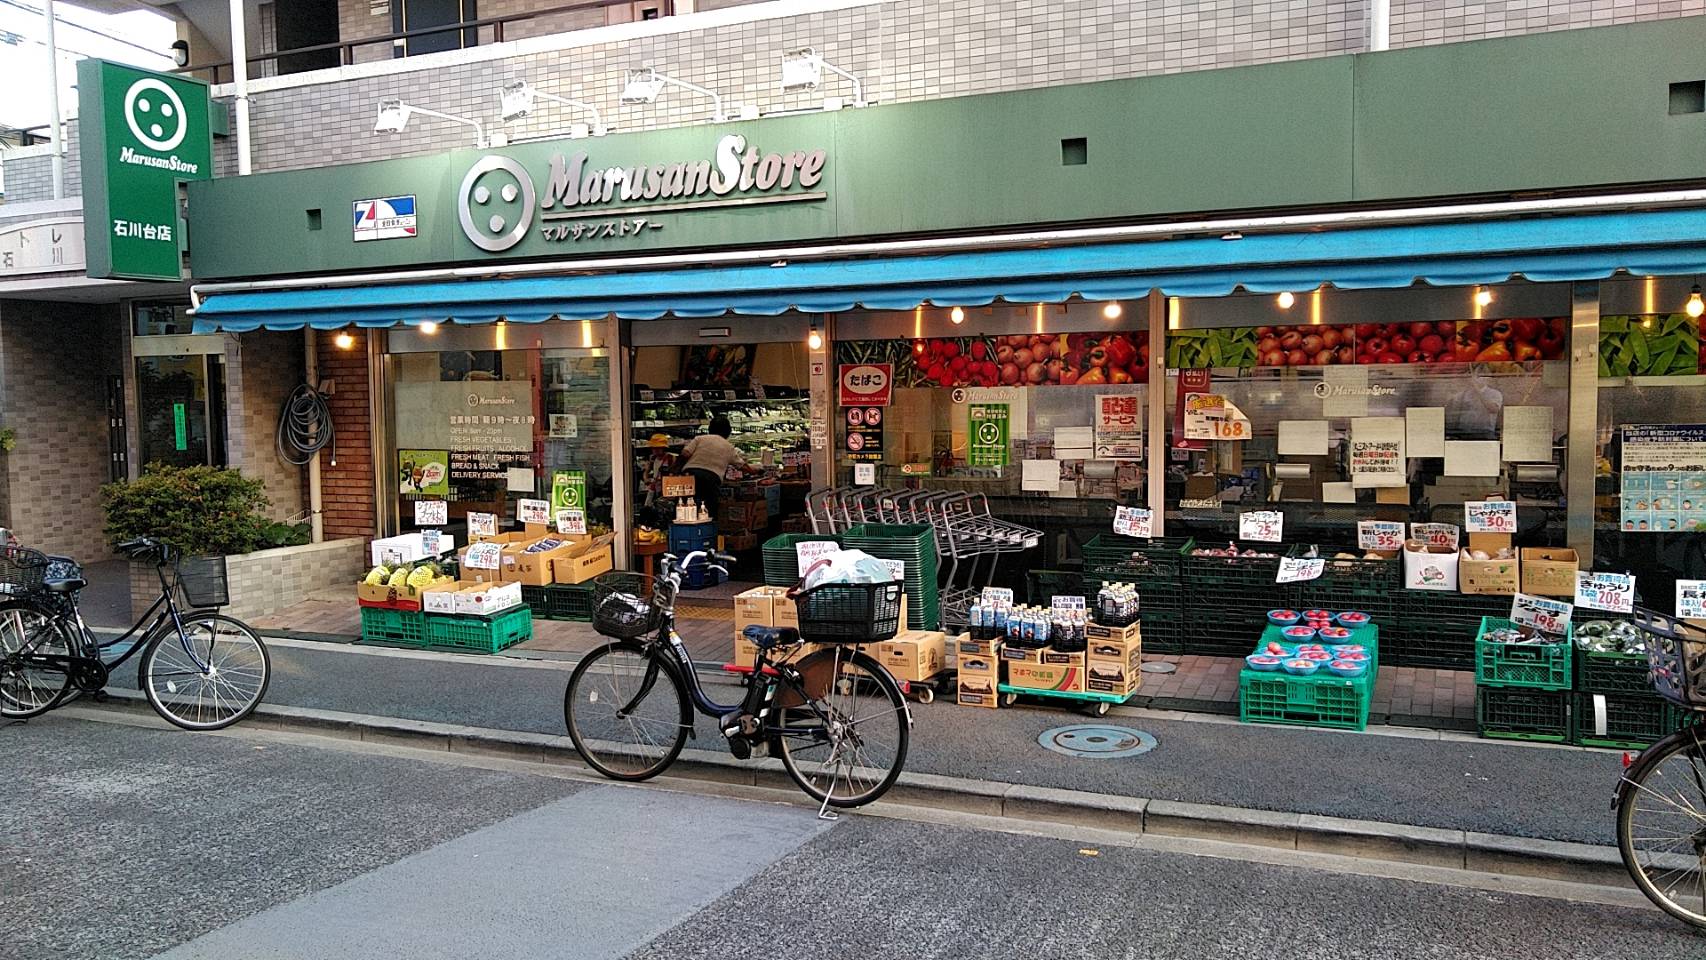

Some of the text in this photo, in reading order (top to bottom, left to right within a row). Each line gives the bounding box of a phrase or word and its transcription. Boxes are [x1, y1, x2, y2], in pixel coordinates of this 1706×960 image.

[120, 146, 198, 174] MarusanStore
[541, 134, 826, 209] MarusanStore
[114, 219, 172, 241] 石川台店
[541, 218, 664, 242] マルサンストアー
[850, 374, 882, 387] たばこ
[1102, 397, 1138, 415] 配達
[1103, 416, 1137, 425] サービス
[1214, 421, 1243, 437] 168
[494, 454, 514, 462] FRESH
[515, 454, 531, 462] FISH
[451, 462, 473, 470] BREAD
[479, 462, 500, 470] SNACK
[451, 471, 480, 479] DELIVERY
[1469, 509, 1513, 517] じゃが芋
[1486, 516, 1514, 527] 30円
[1361, 528, 1402, 537] 新じゃが
[1580, 579, 1631, 593] きゅうり
[1598, 590, 1630, 607] 208円
